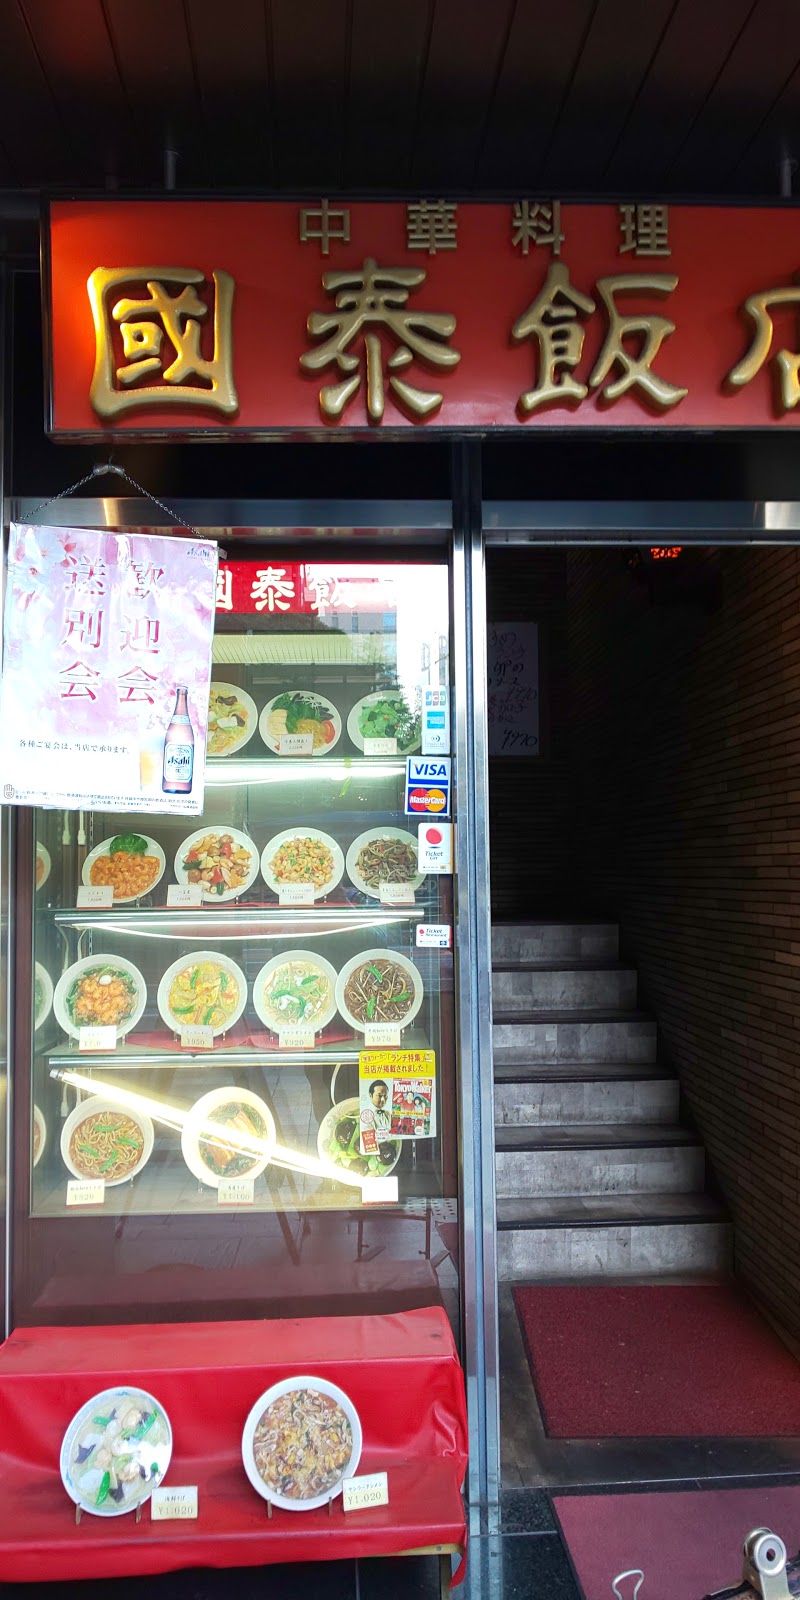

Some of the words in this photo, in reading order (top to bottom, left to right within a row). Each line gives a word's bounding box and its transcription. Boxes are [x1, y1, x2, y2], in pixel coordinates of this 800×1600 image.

[299, 199, 673, 256] 中華料理
[187, 546, 210, 557] Asahi
[59, 555, 107, 702] 送別会
[118, 560, 165, 705] 歓迎会
[425, 690, 447, 706] JCB
[168, 755, 190, 765] Asahi
[413, 763, 447, 776] VISA
[409, 795, 445, 804] MasterCard
[363, 1063, 429, 1074] 当店が掲載されました！
[348, 1482, 383, 1492] サンラータンメン
[348, 1491, 381, 1505] ¥1,020
[158, 1506, 193, 1515] ¥1,020
